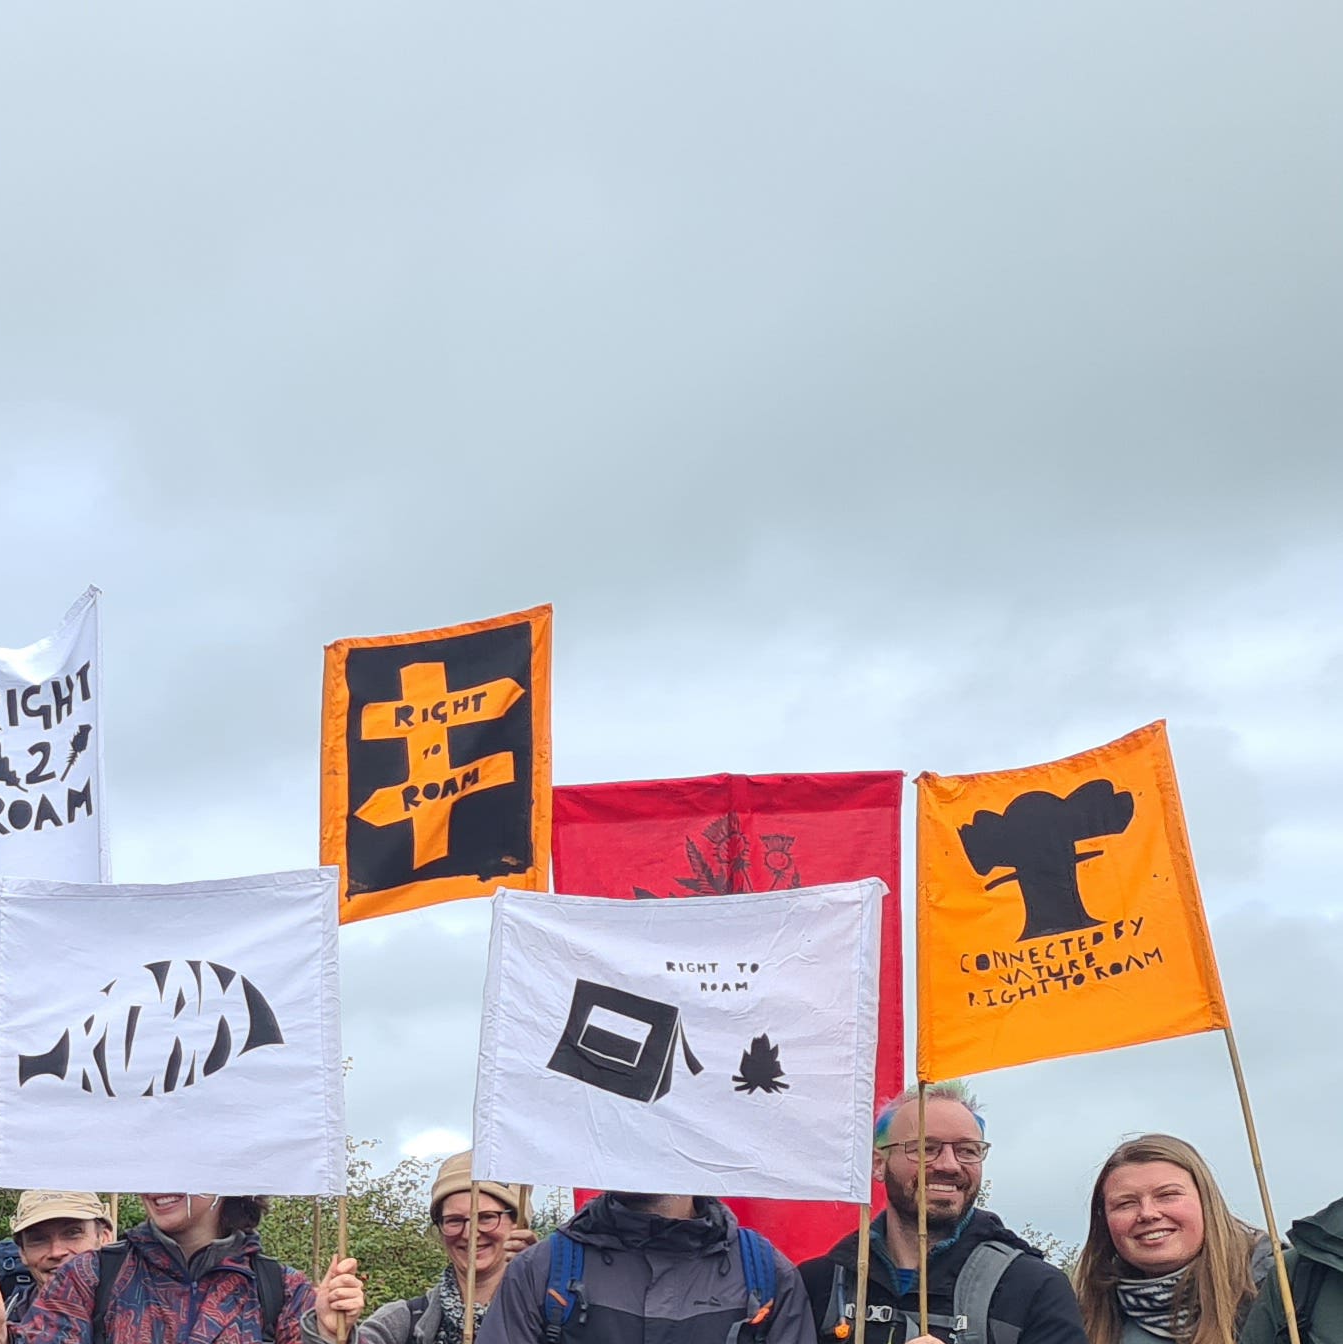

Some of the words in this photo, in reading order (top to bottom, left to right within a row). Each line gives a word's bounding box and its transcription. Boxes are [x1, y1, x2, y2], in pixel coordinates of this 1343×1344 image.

[394, 691, 488, 728] RIGHT
[25, 741, 57, 785] 2
[422, 743, 442, 760] TO
[401, 767, 480, 812] ROAM
[960, 931, 1104, 973] CONNECTED
[1113, 916, 1144, 940] BY
[665, 961, 719, 973] RIGHT
[736, 962, 760, 974] TO
[968, 978, 1051, 1007] RIGHT
[1054, 972, 1086, 991] TO
[1094, 947, 1164, 981] ROAM
[998, 951, 1096, 986] NATURE
[700, 981, 749, 993] ROAM
